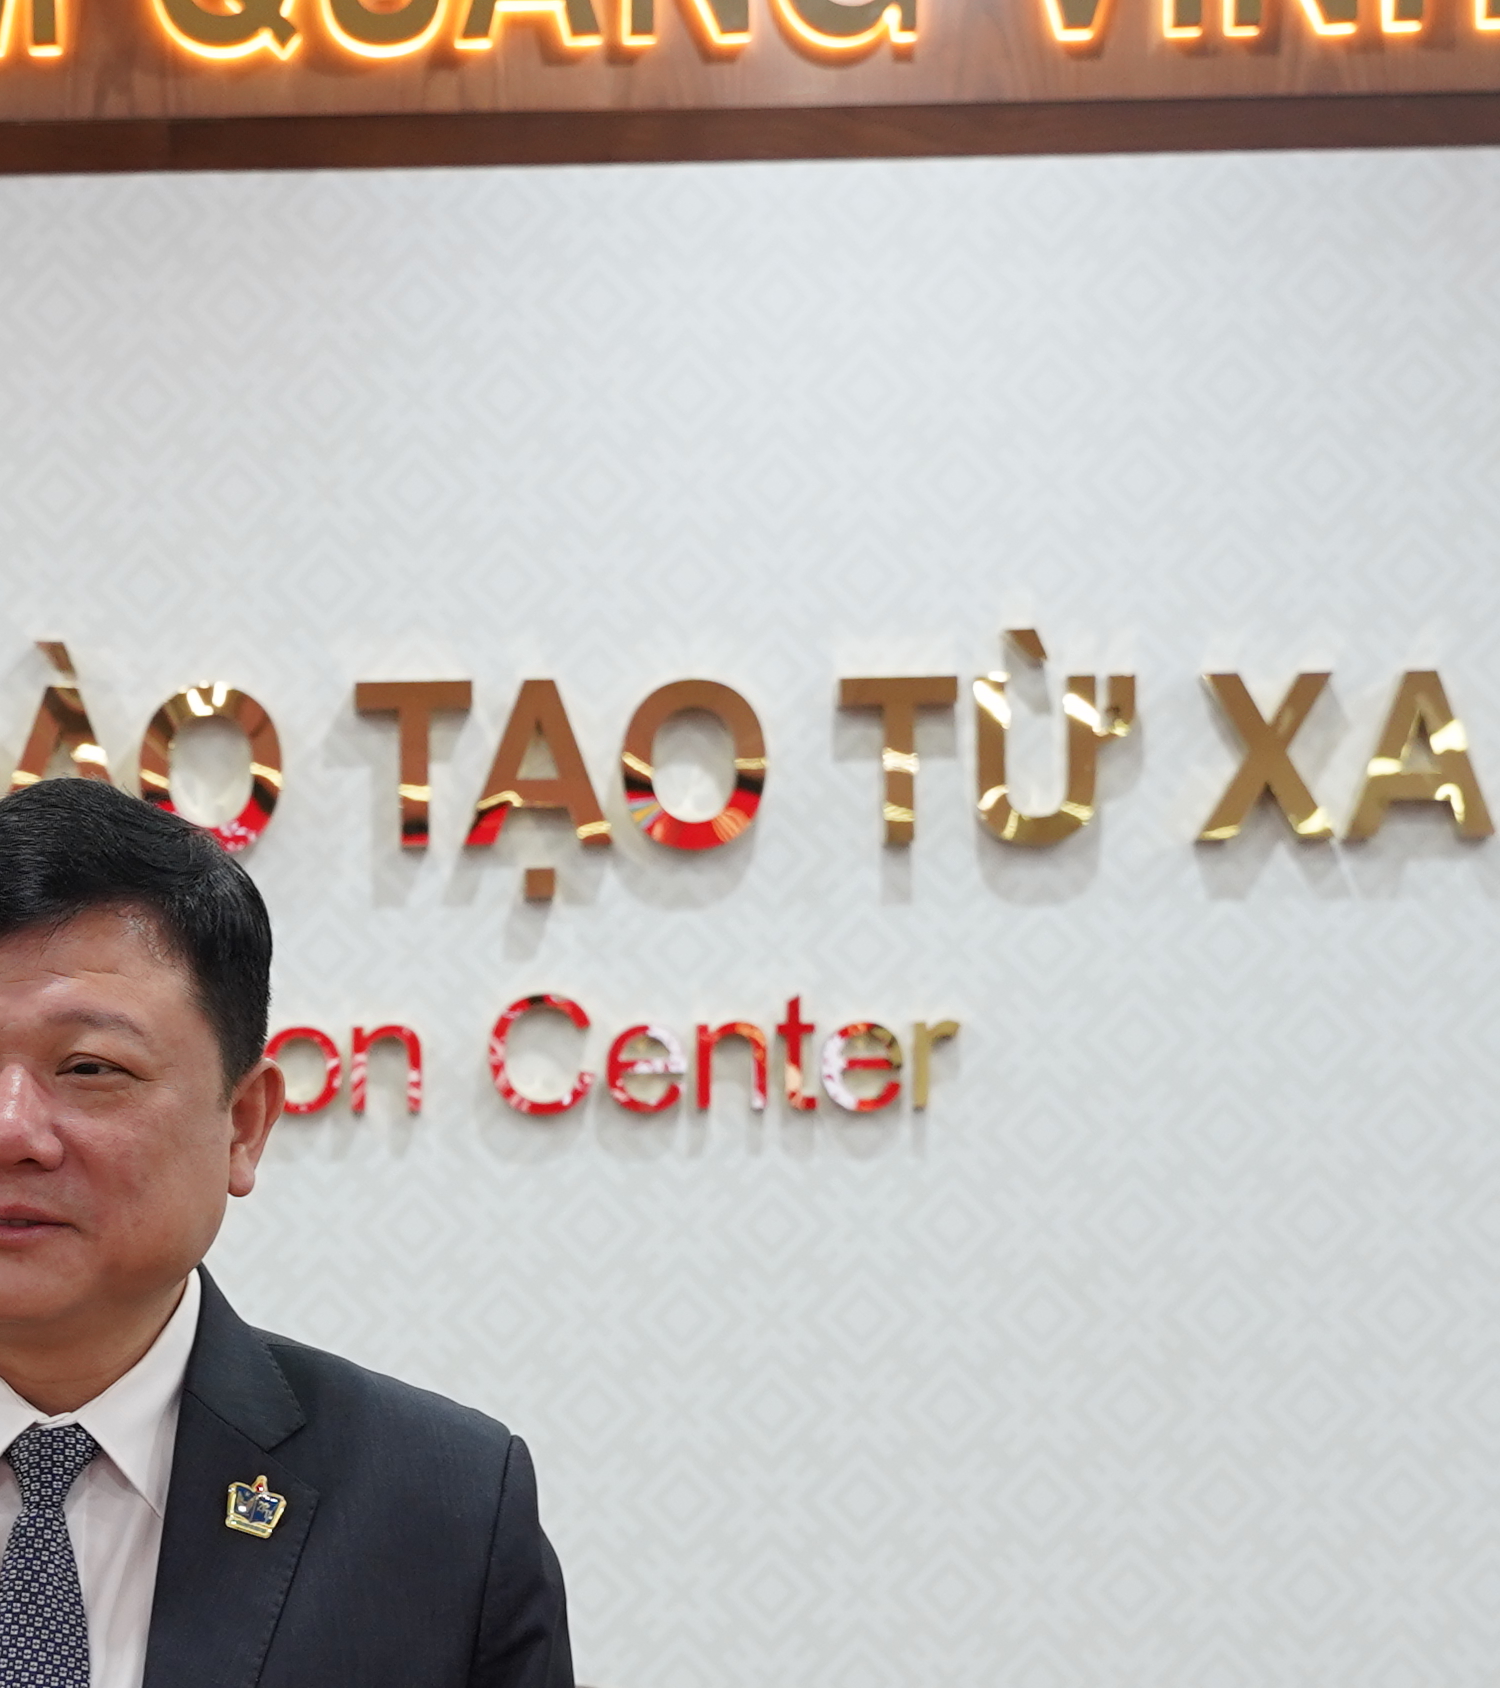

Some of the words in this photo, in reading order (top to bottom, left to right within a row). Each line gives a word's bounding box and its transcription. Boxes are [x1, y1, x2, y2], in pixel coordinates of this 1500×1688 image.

[353, 676, 770, 903] TẠO
[837, 626, 1140, 848] TỪ
[1195, 667, 1496, 845] XA
[489, 990, 962, 1119] Center
